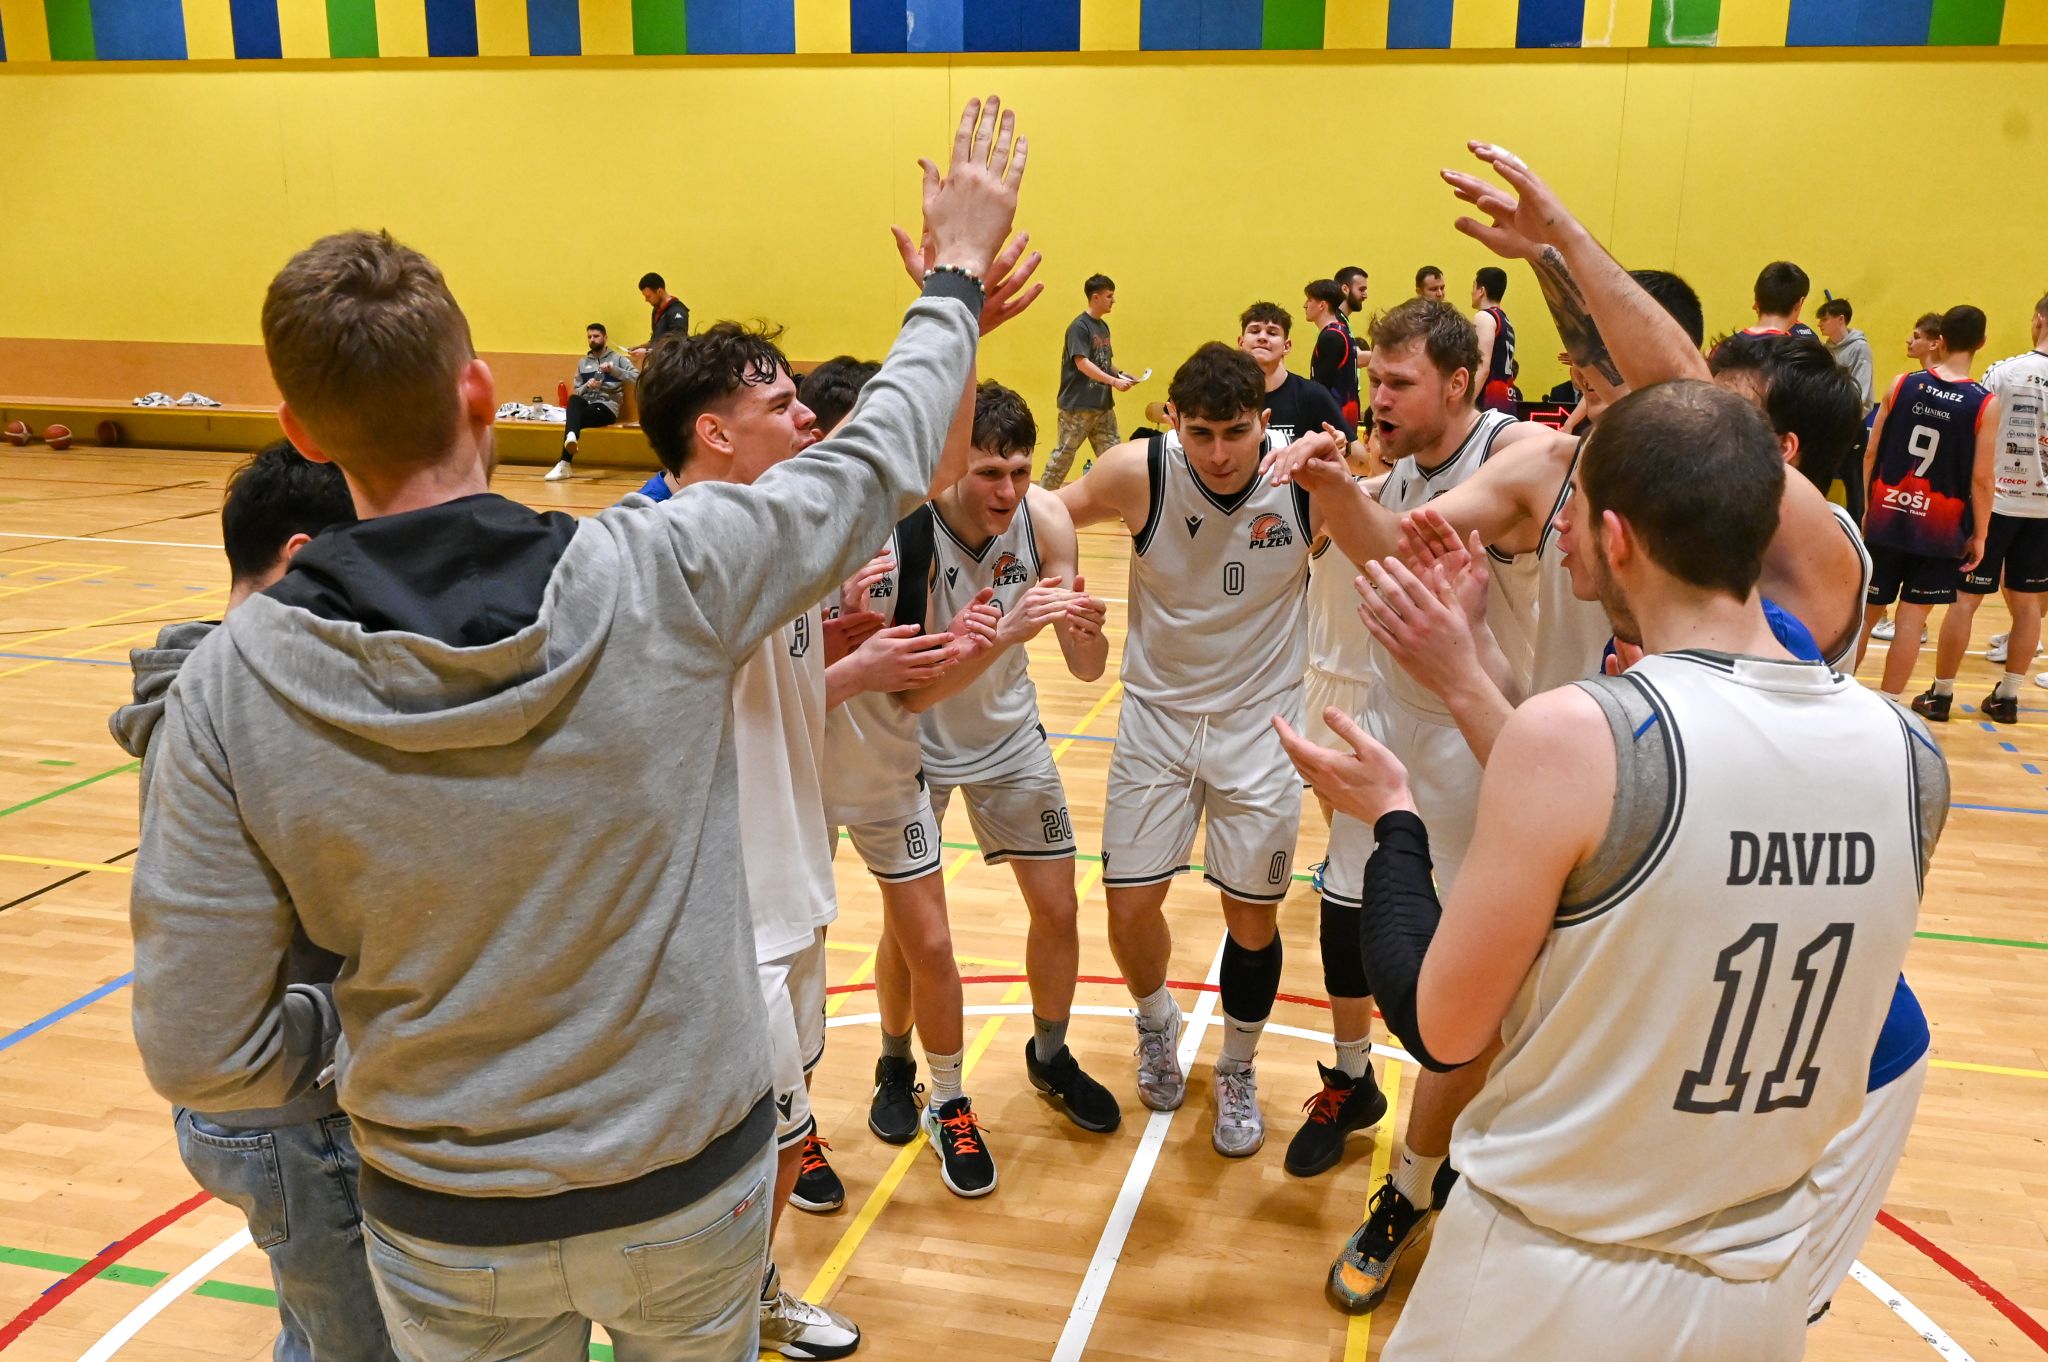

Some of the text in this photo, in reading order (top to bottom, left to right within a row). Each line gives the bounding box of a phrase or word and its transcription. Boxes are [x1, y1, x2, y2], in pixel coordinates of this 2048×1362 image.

[1926, 385, 1964, 403] STAREZ
[1924, 406, 1951, 419] UNIKOL
[1908, 424, 1940, 477] 9
[1884, 488, 1931, 511] ZOŠI
[1249, 536, 1293, 549] PLZEN
[870, 587, 893, 598] ZEN
[1223, 562, 1245, 596] 0
[904, 821, 928, 860] 8
[1041, 806, 1073, 843] 20
[1268, 850, 1285, 885] 0
[1727, 831, 1875, 886] DAVID
[1673, 922, 1855, 1114] 11
